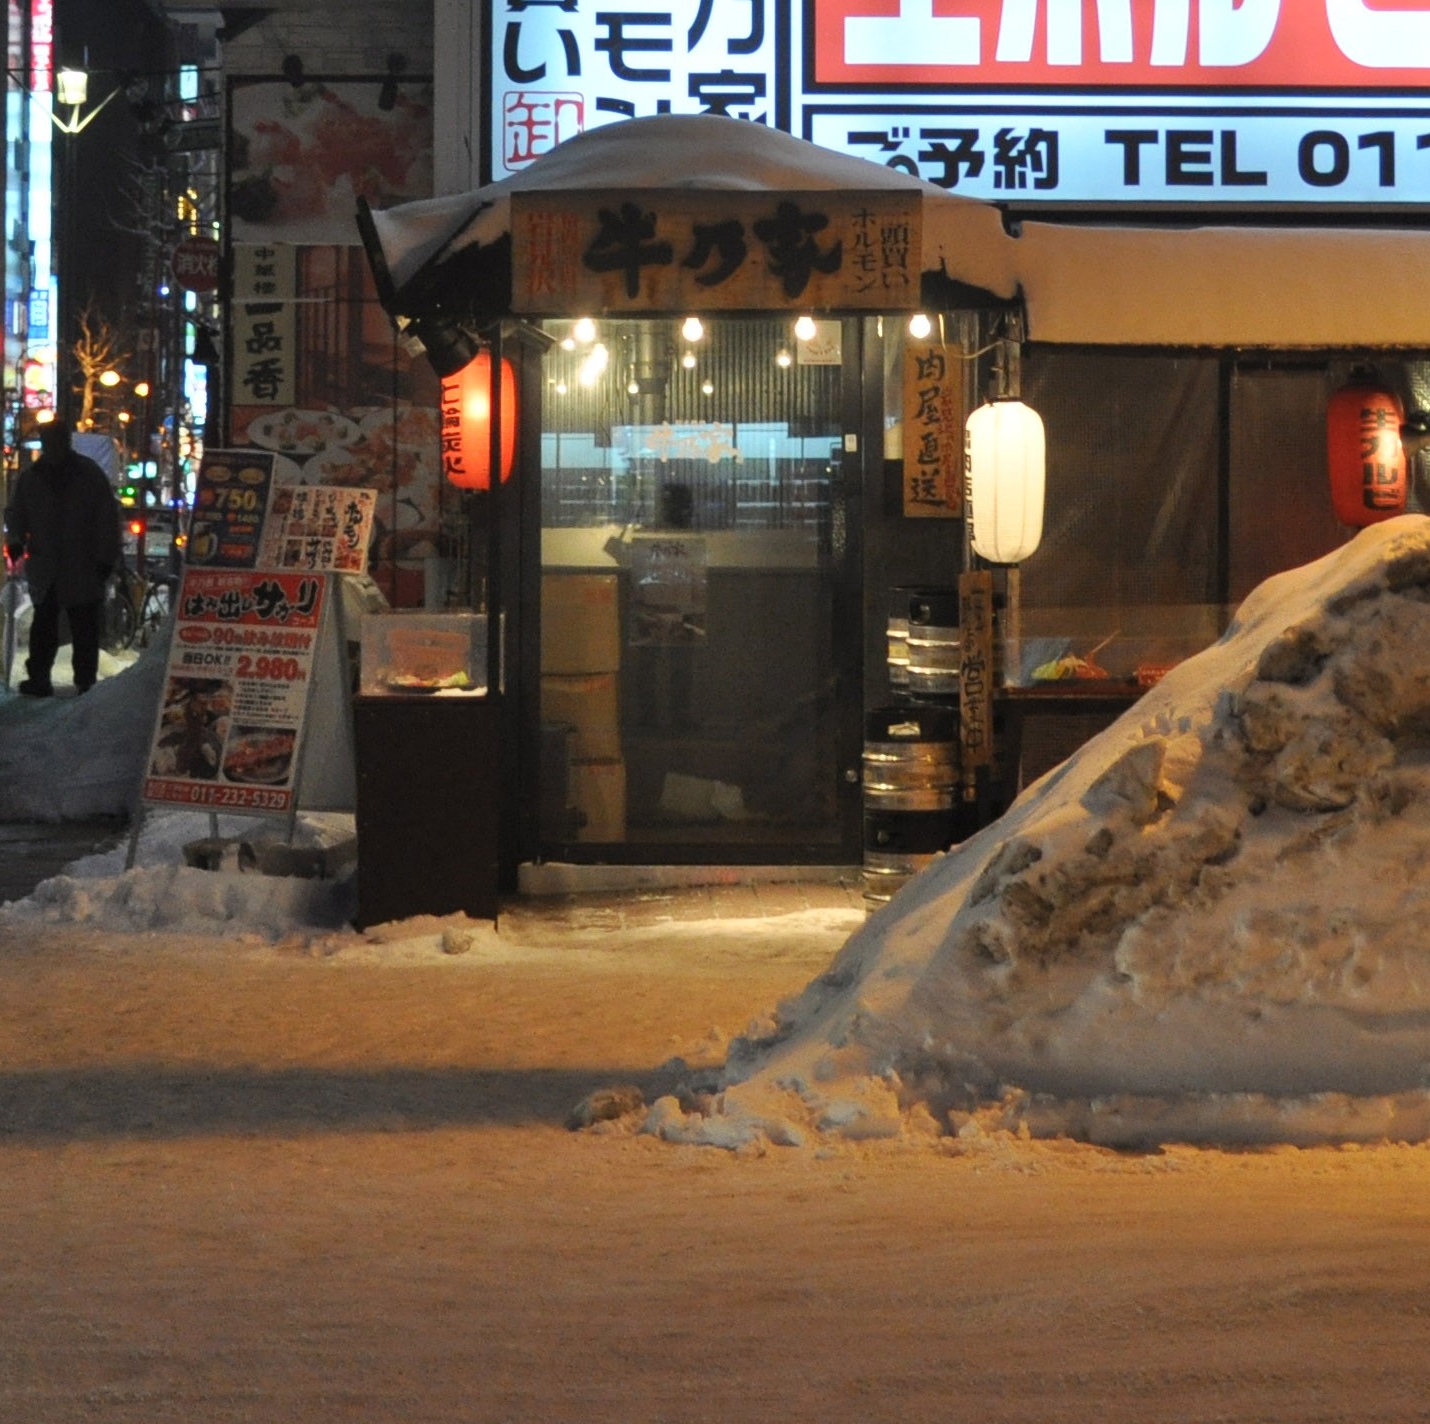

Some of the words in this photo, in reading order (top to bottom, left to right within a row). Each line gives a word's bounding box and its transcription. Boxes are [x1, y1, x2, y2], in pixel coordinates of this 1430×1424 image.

[1105, 130, 1268, 187] TEL
[852, 207, 878, 293] ホルモン
[243, 303, 284, 400] 一品香
[910, 350, 946, 507] 肉屋直送
